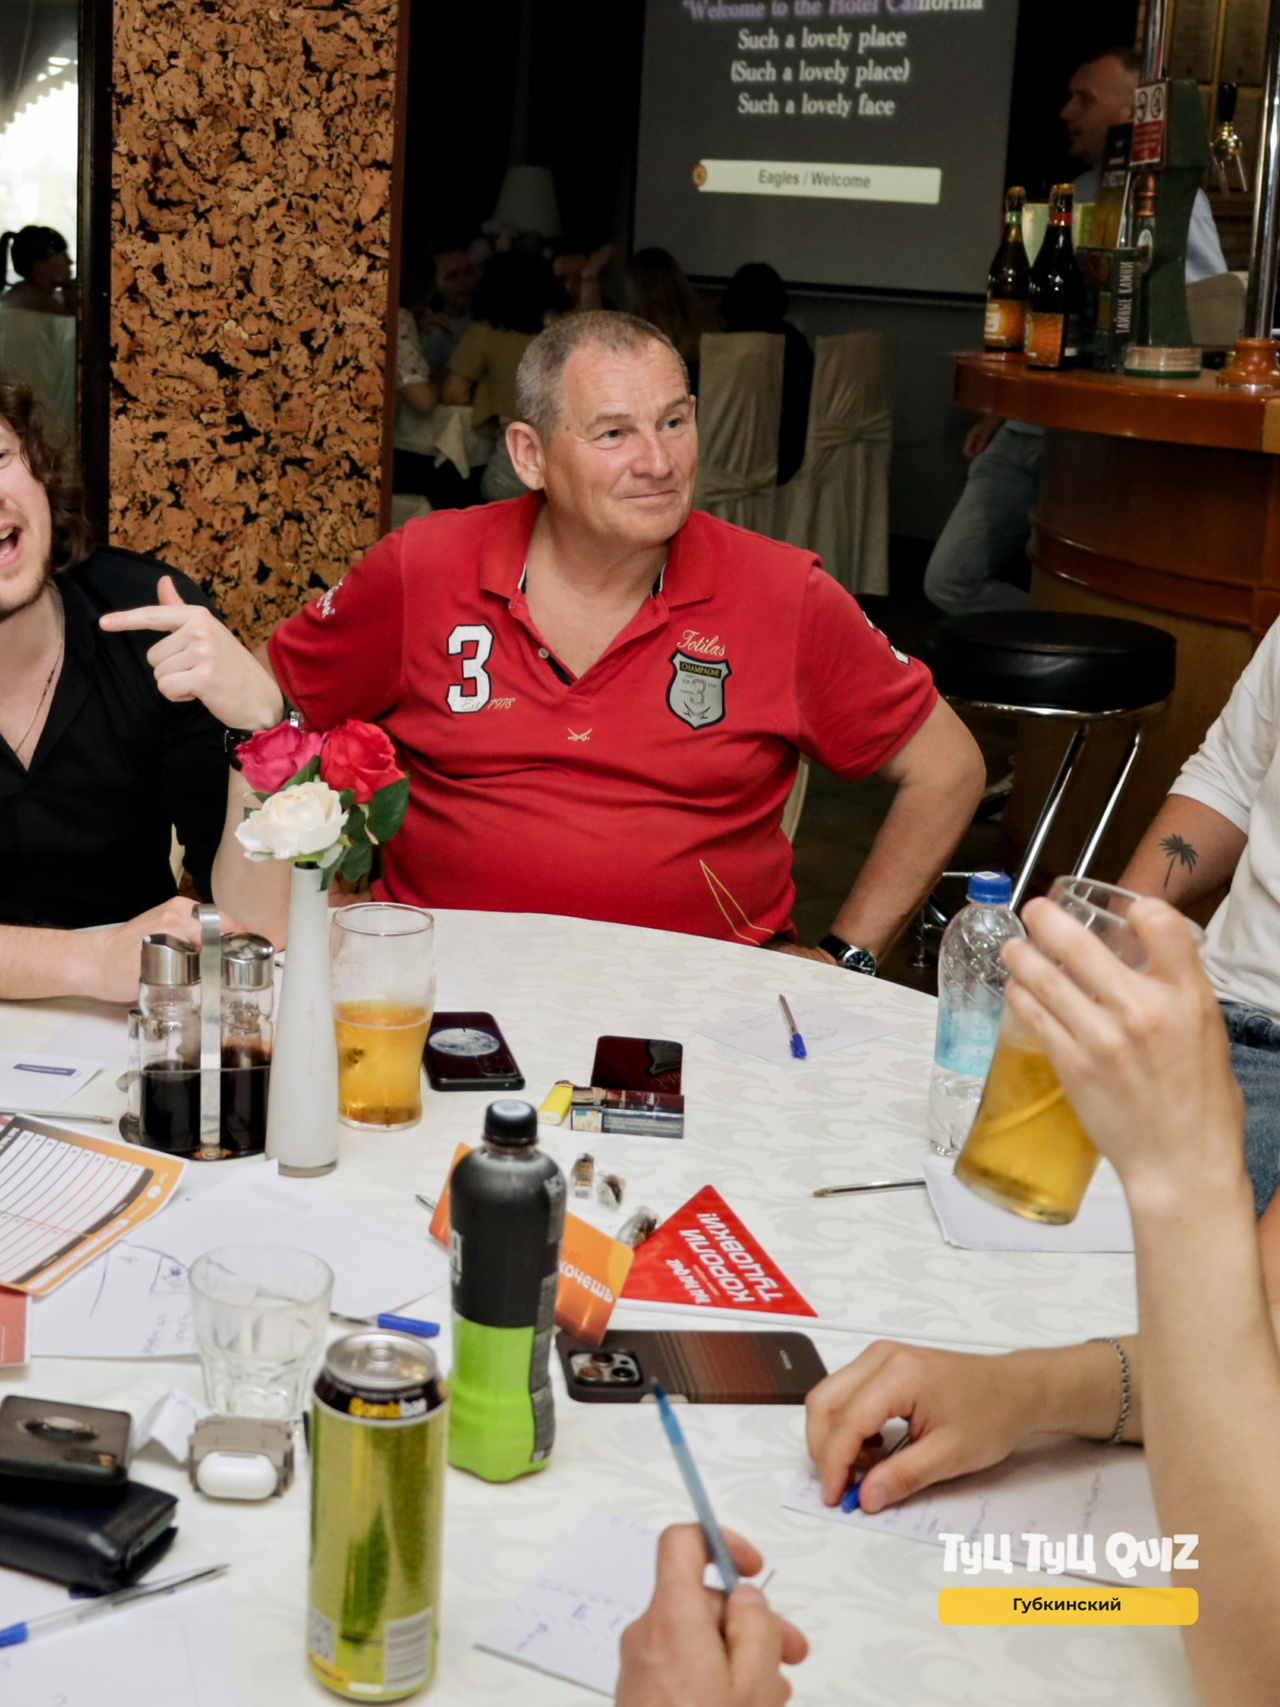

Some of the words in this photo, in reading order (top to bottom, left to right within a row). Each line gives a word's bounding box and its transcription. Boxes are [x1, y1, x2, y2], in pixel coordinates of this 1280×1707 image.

[771, 0, 788, 16] to
[794, 0, 820, 15] the
[738, 28, 779, 50] Such
[785, 34, 795, 49] a
[801, 25, 851, 51] lovely
[857, 24, 907, 54] place
[731, 60, 776, 82] (Such
[782, 67, 792, 81] a
[799, 59, 849, 85] lovely
[854, 58, 910, 88] place)
[738, 92, 779, 114] Such
[785, 99, 795, 114] a
[802, 93, 851, 117] lovely
[857, 92, 895, 115] face
[758, 170, 800, 188] Eagles
[811, 171, 871, 188] Welcome
[677, 629, 726, 656] Totilas
[446, 624, 494, 714] 3
[681, 663, 720, 678] CHAMPAGNE
[486, 697, 516, 710] 1978
[689, 678, 708, 706] 3
[679, 1229, 755, 1302] КОРОЛИ
[697, 1213, 783, 1302] ТУЦОВКИ!
